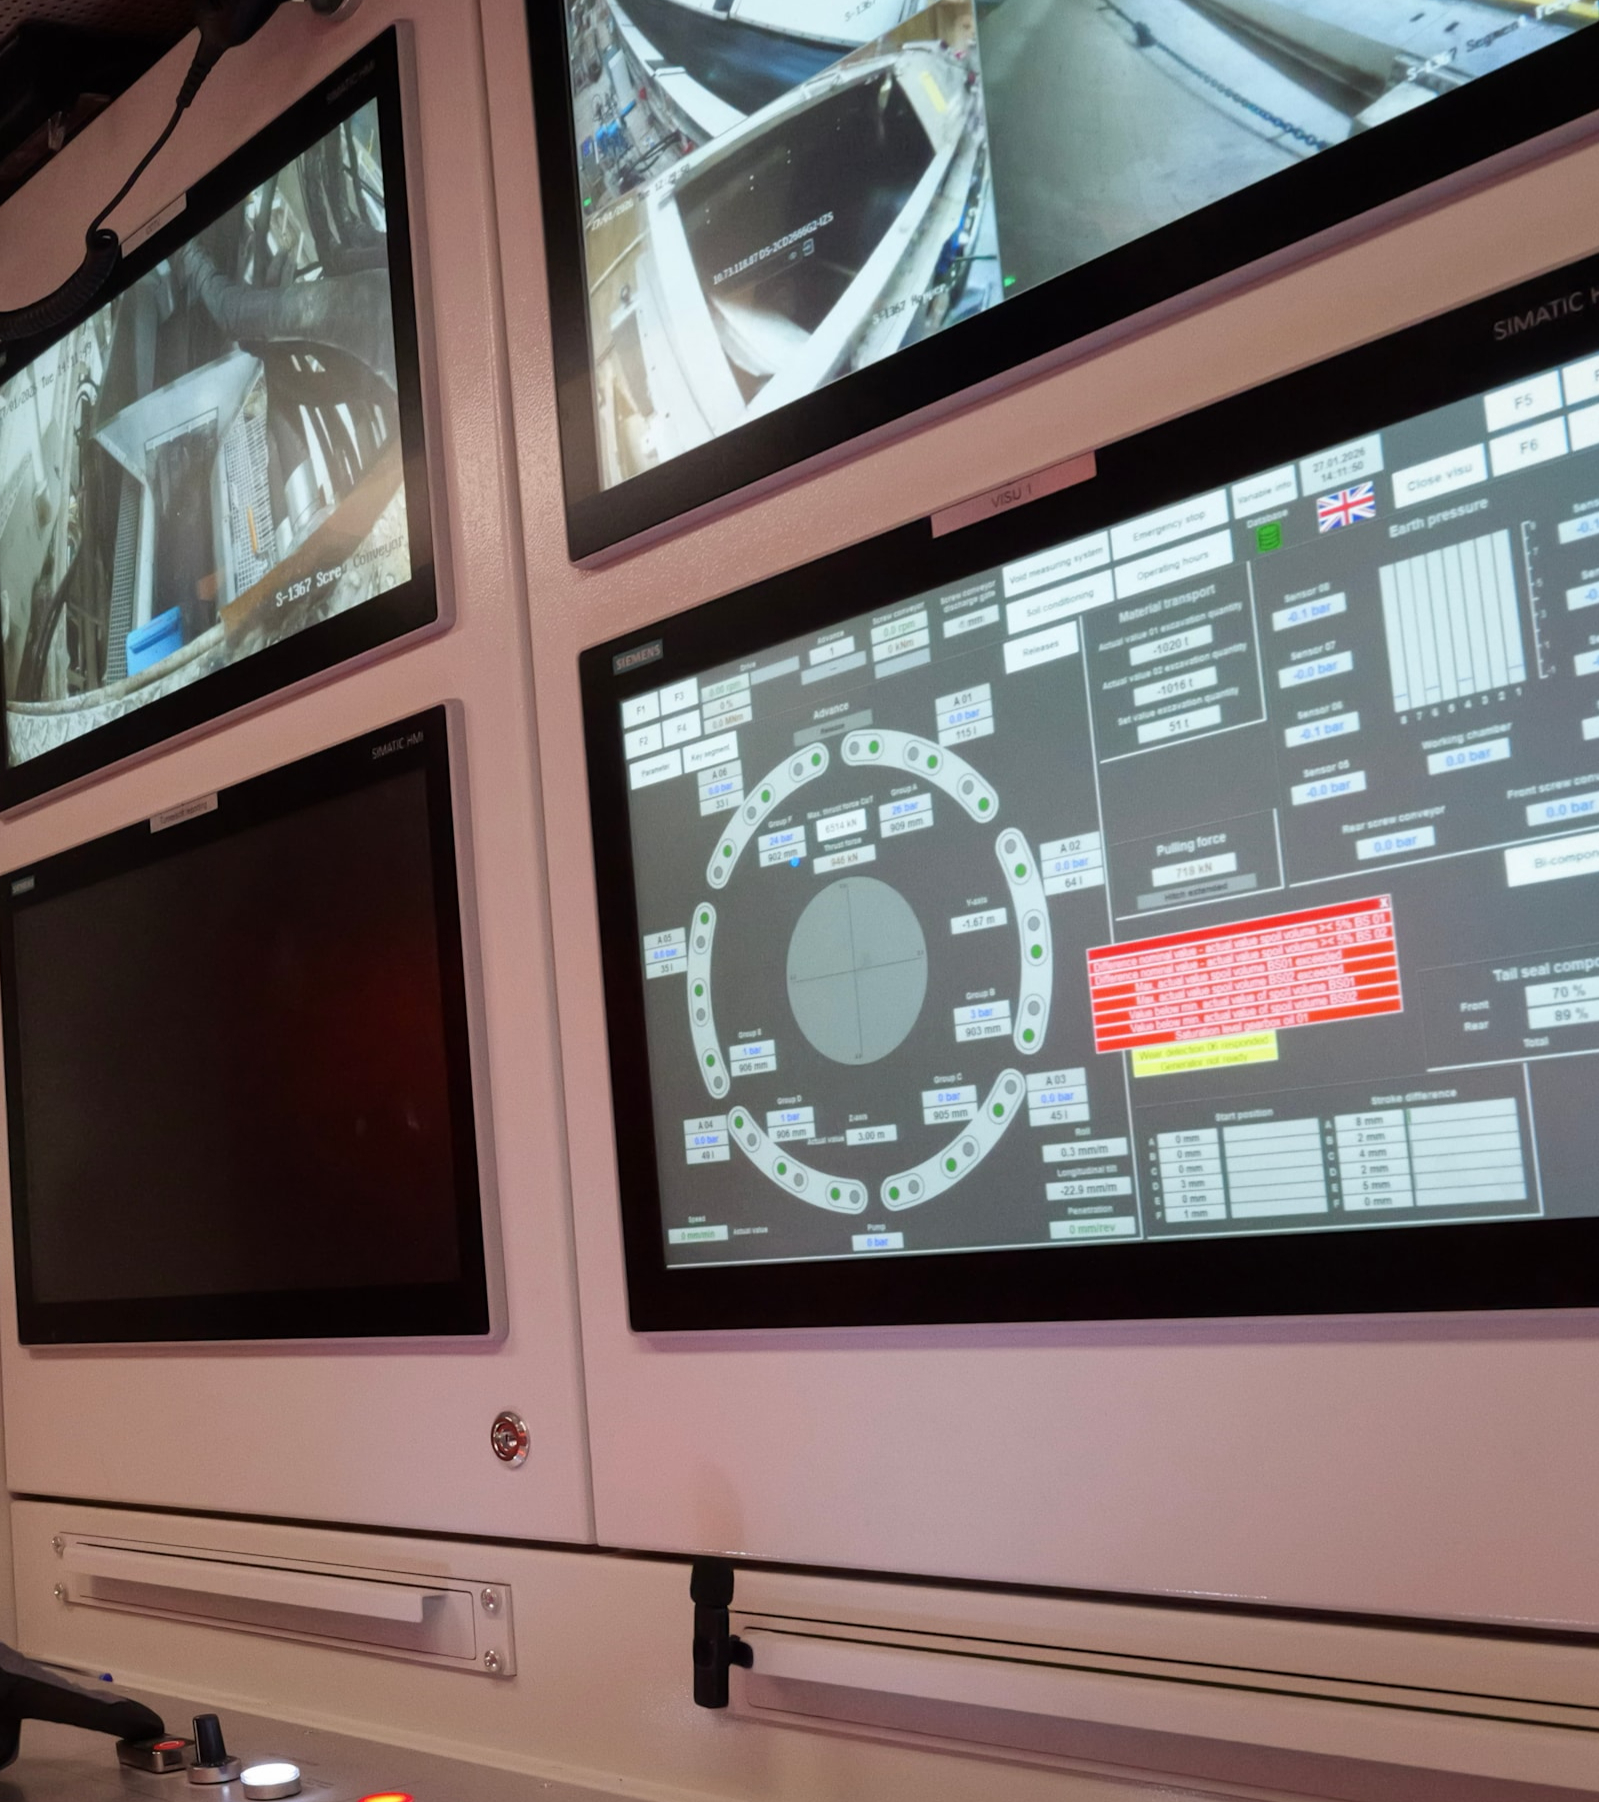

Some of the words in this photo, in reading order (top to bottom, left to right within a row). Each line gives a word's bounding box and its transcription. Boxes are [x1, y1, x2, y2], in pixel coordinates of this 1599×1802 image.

[1493, 291, 1584, 341] SIMATIC
[1514, 393, 1533, 410] F5
[1519, 438, 1539, 455] F6
[1312, 447, 1366, 473] 27.01.2026
[1321, 460, 1364, 482] 14:11:50
[1406, 473, 1443, 493] Close
[1446, 462, 1473, 480] visu
[991, 487, 1023, 509] VISU
[1133, 520, 1183, 542] Emergency
[1185, 510, 1205, 524] stop
[1246, 509, 1289, 528] Database
[1388, 517, 1424, 538] Earth
[1427, 498, 1489, 529] pressure
[275, 577, 312, 607] S-1367
[353, 535, 405, 568] Conveyor
[1009, 572, 1027, 586] Void
[1029, 558, 1071, 578] measuring
[1073, 547, 1103, 565] system
[1136, 561, 1180, 582] Operating
[1182, 551, 1209, 566] hours
[1284, 586, 1316, 603] Sensor
[1026, 605, 1041, 618] Soil
[1042, 589, 1094, 612] conditioning
[1118, 601, 1162, 624] Material
[1163, 584, 1216, 609] transport
[1310, 602, 1332, 616] bar
[817, 630, 845, 645] Advance
[1125, 631, 1147, 643] value
[1022, 640, 1060, 657] Releases
[1153, 639, 1182, 654] -1020
[1291, 643, 1322, 660] Sensor
[615, 644, 661, 671] SIEMENS
[1317, 660, 1338, 674] bar
[1102, 676, 1127, 690] Actual
[1129, 670, 1152, 682] value
[1157, 679, 1186, 695] -1016
[674, 691, 684, 702] F3
[636, 705, 645, 716] F1
[813, 702, 850, 720] Advance
[1118, 715, 1132, 726] Set
[1133, 710, 1155, 722] value
[1297, 703, 1328, 720] Sensor
[677, 723, 687, 734] F4
[1169, 721, 1182, 732] 51
[1323, 720, 1344, 734] bar
[639, 735, 648, 747] F2
[1421, 732, 1465, 751] Working
[1466, 721, 1512, 742] chamber
[1445, 753, 1467, 767] 0.0
[1469, 748, 1492, 762] bar
[1303, 761, 1335, 778] Sensor
[1330, 778, 1351, 792] bar
[1507, 785, 1537, 800] Front
[1538, 779, 1572, 793] screw
[904, 801, 919, 812] bar
[1545, 803, 1567, 818] 0.0
[1570, 799, 1595, 814] bar
[907, 818, 923, 828] mm
[1342, 822, 1365, 834] Rear
[1367, 814, 1397, 829] screw
[1399, 805, 1446, 823] conveyor
[1156, 838, 1195, 857] Pulling
[1197, 833, 1227, 848] force
[1374, 839, 1395, 853] 0.0
[1396, 835, 1417, 849] bar
[1072, 856, 1089, 868] bar
[1199, 862, 1213, 874] kN
[1065, 876, 1078, 888] 64
[962, 916, 985, 928] -1.67
[1492, 967, 1518, 982] Tail
[1520, 962, 1551, 978] seal
[1553, 986, 1569, 999] 70
[1460, 1000, 1489, 1013] Front
[1554, 1008, 1571, 1021] 89
[984, 1023, 1001, 1034] mm
[1463, 1020, 1489, 1032] Rear
[1523, 1035, 1549, 1048] Total
[951, 1108, 968, 1118] mm
[1364, 1115, 1383, 1125] mm
[1078, 1144, 1108, 1155] mm/m
[1060, 1185, 1084, 1196] -22.9
[1087, 1182, 1117, 1193] mm/m
[1078, 1222, 1116, 1233] mm/rev
